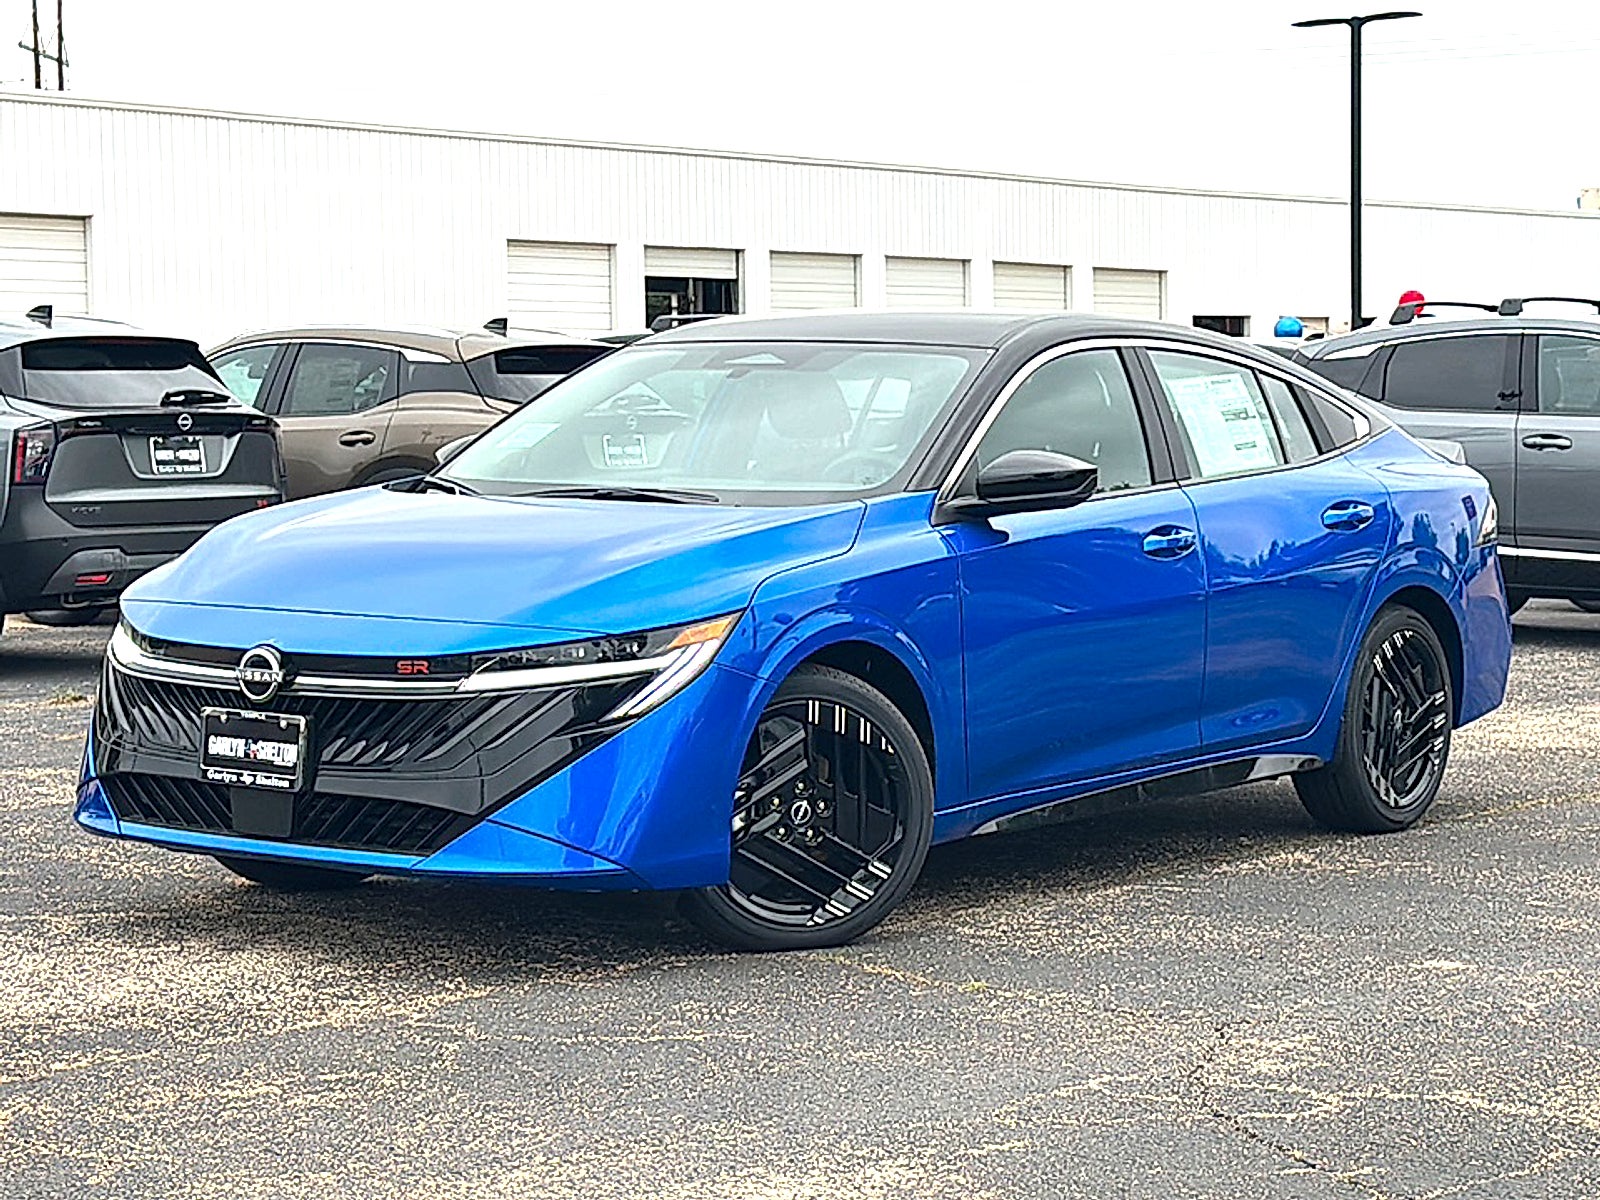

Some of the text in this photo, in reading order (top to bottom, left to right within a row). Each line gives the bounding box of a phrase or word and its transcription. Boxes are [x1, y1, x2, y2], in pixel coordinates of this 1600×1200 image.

[396, 660, 430, 675] SR
[238, 669, 284, 683] NISSAN
[208, 734, 299, 764] GARLYN SHELTON
